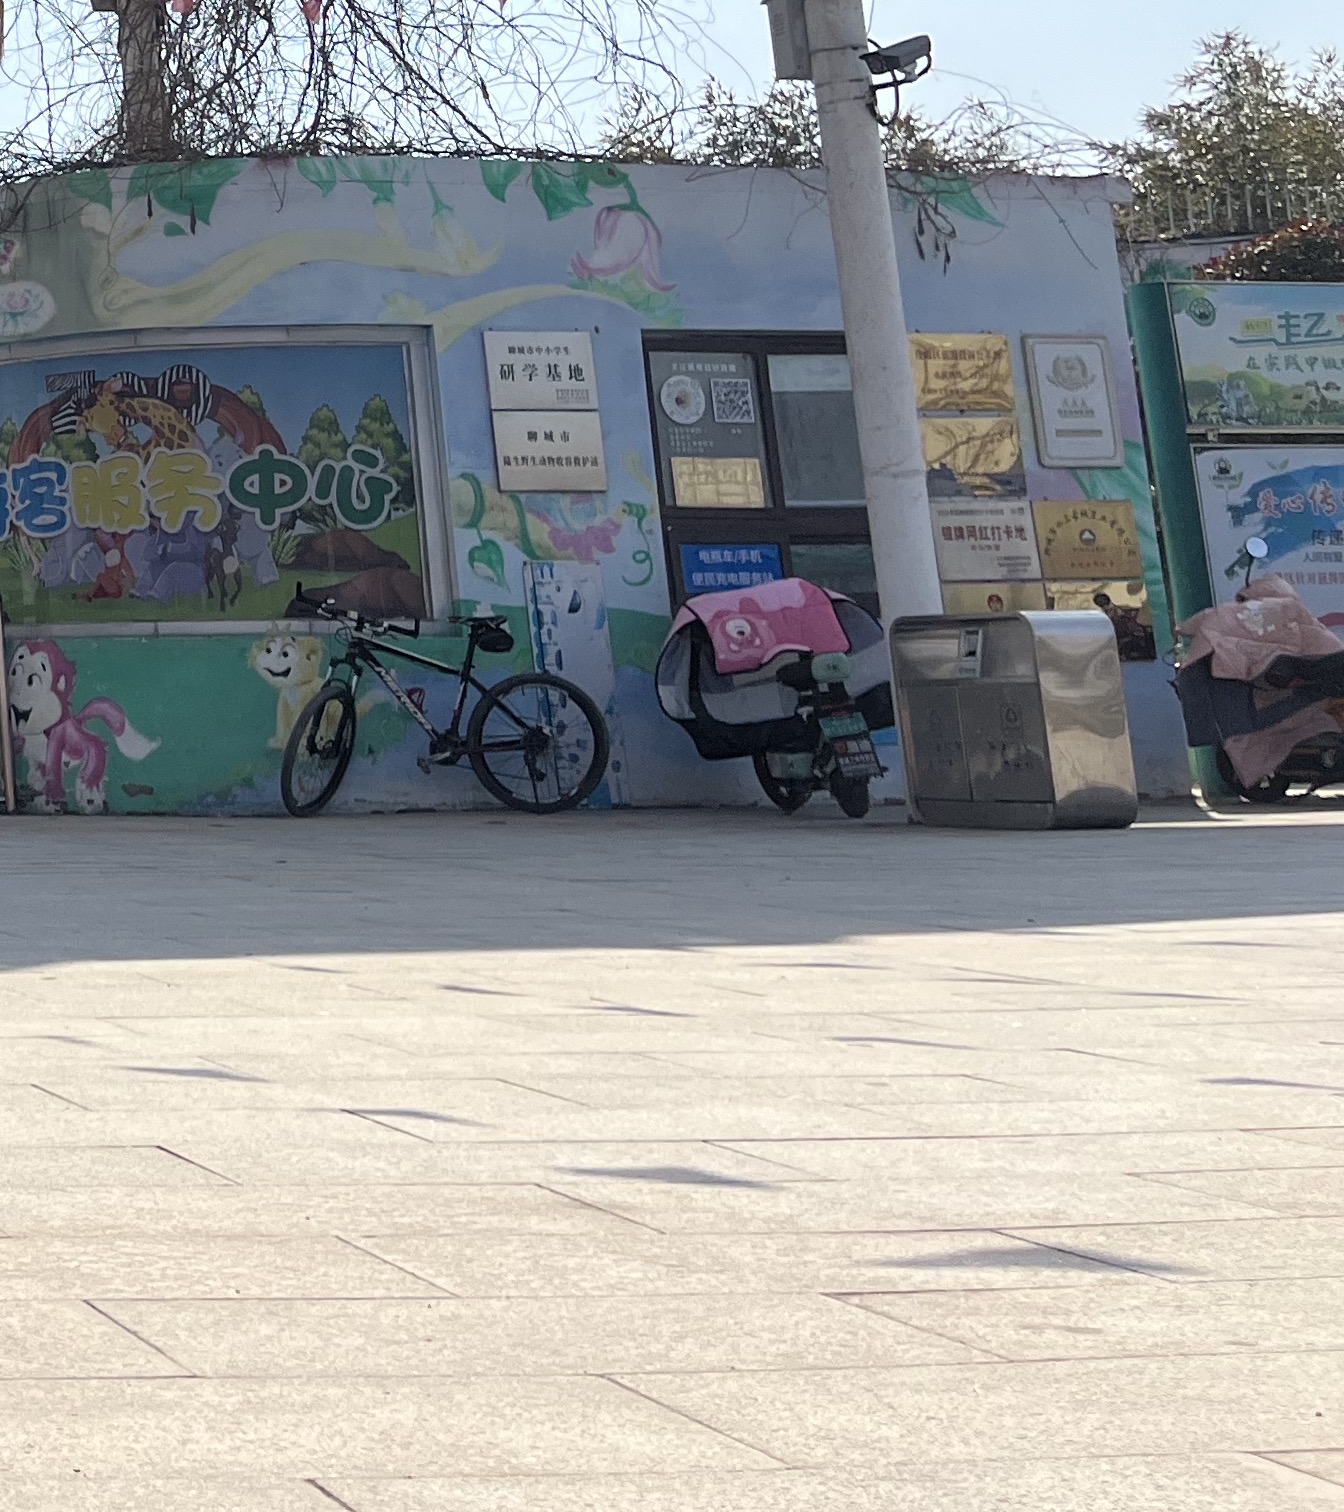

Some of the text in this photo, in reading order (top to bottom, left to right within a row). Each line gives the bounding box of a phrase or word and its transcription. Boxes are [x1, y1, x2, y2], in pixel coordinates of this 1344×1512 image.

[499, 363, 586, 382] 研学基地
[527, 431, 570, 444] 聊城市
[1258, 479, 1344, 518] 爱心传
